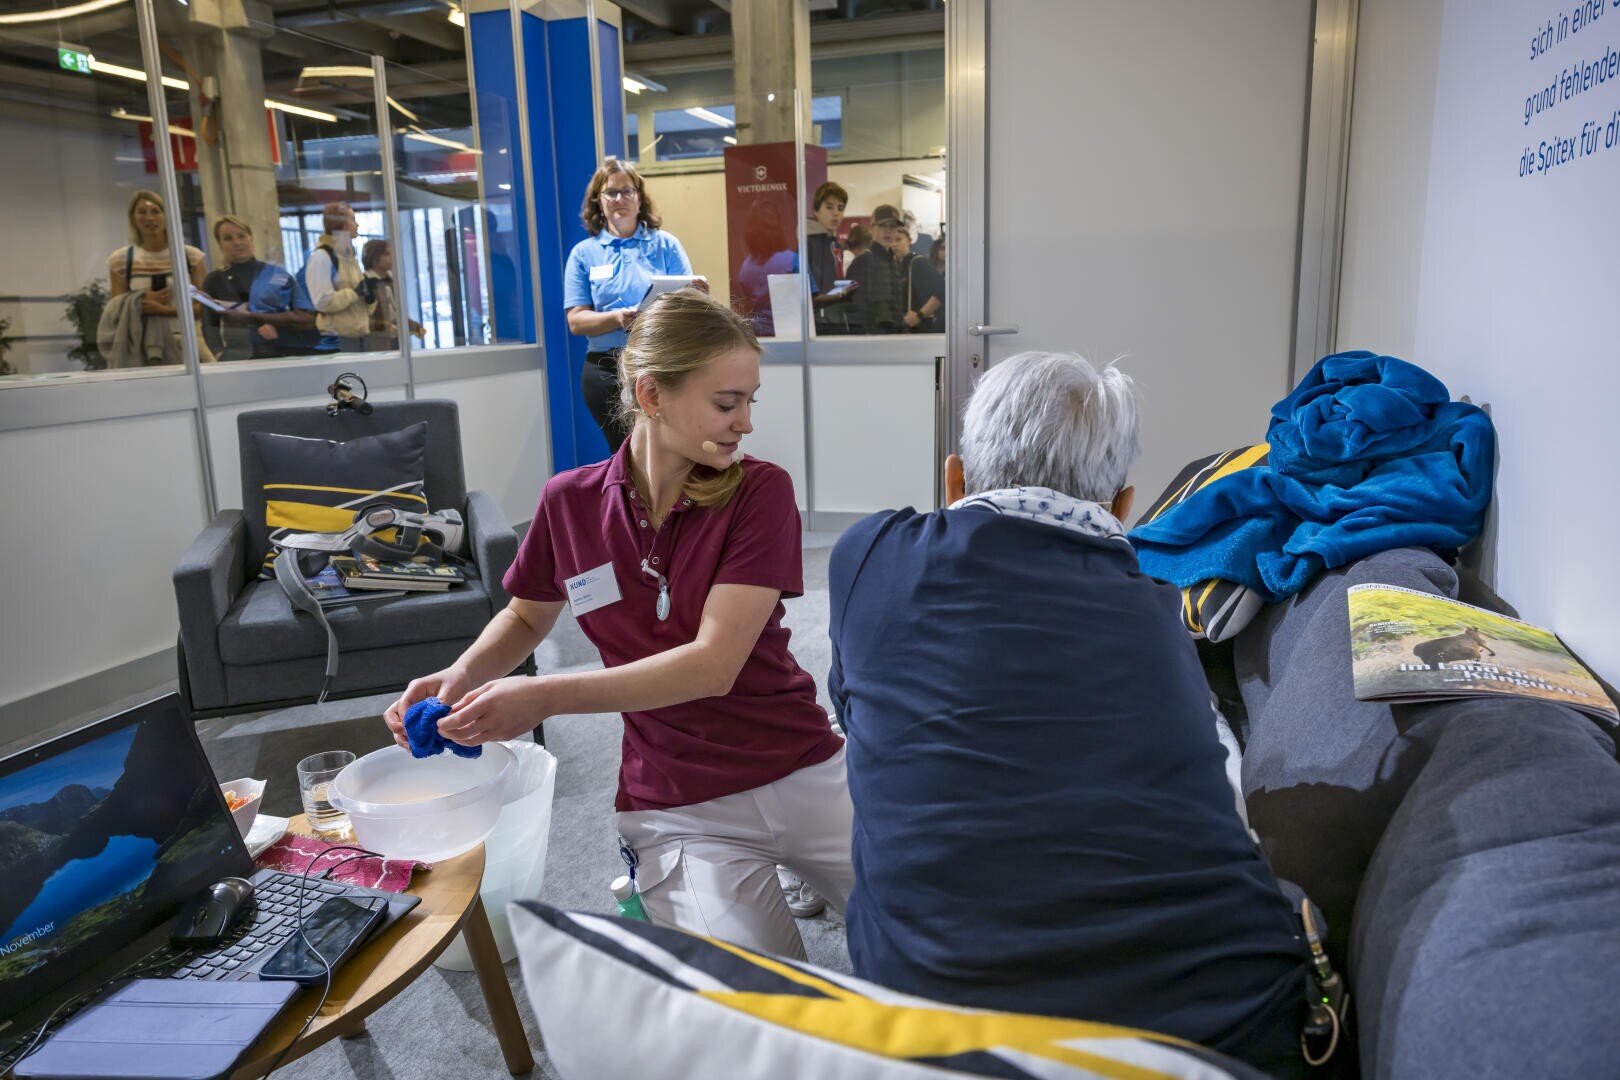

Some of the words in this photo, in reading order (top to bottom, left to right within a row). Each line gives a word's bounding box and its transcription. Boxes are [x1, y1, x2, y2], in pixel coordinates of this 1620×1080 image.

[1530, 19, 1553, 60] sich
[1556, 12, 1568, 44] in
[1524, 74, 1558, 126] grund
[1519, 147, 1535, 177] die
[1537, 136, 1577, 175] Spitex
[1580, 121, 1602, 158] für
[1605, 110, 1620, 149] di
[737, 183, 788, 192] VICTORINOX
[1438, 662, 1499, 674] Land
[0, 921, 55, 957] November
